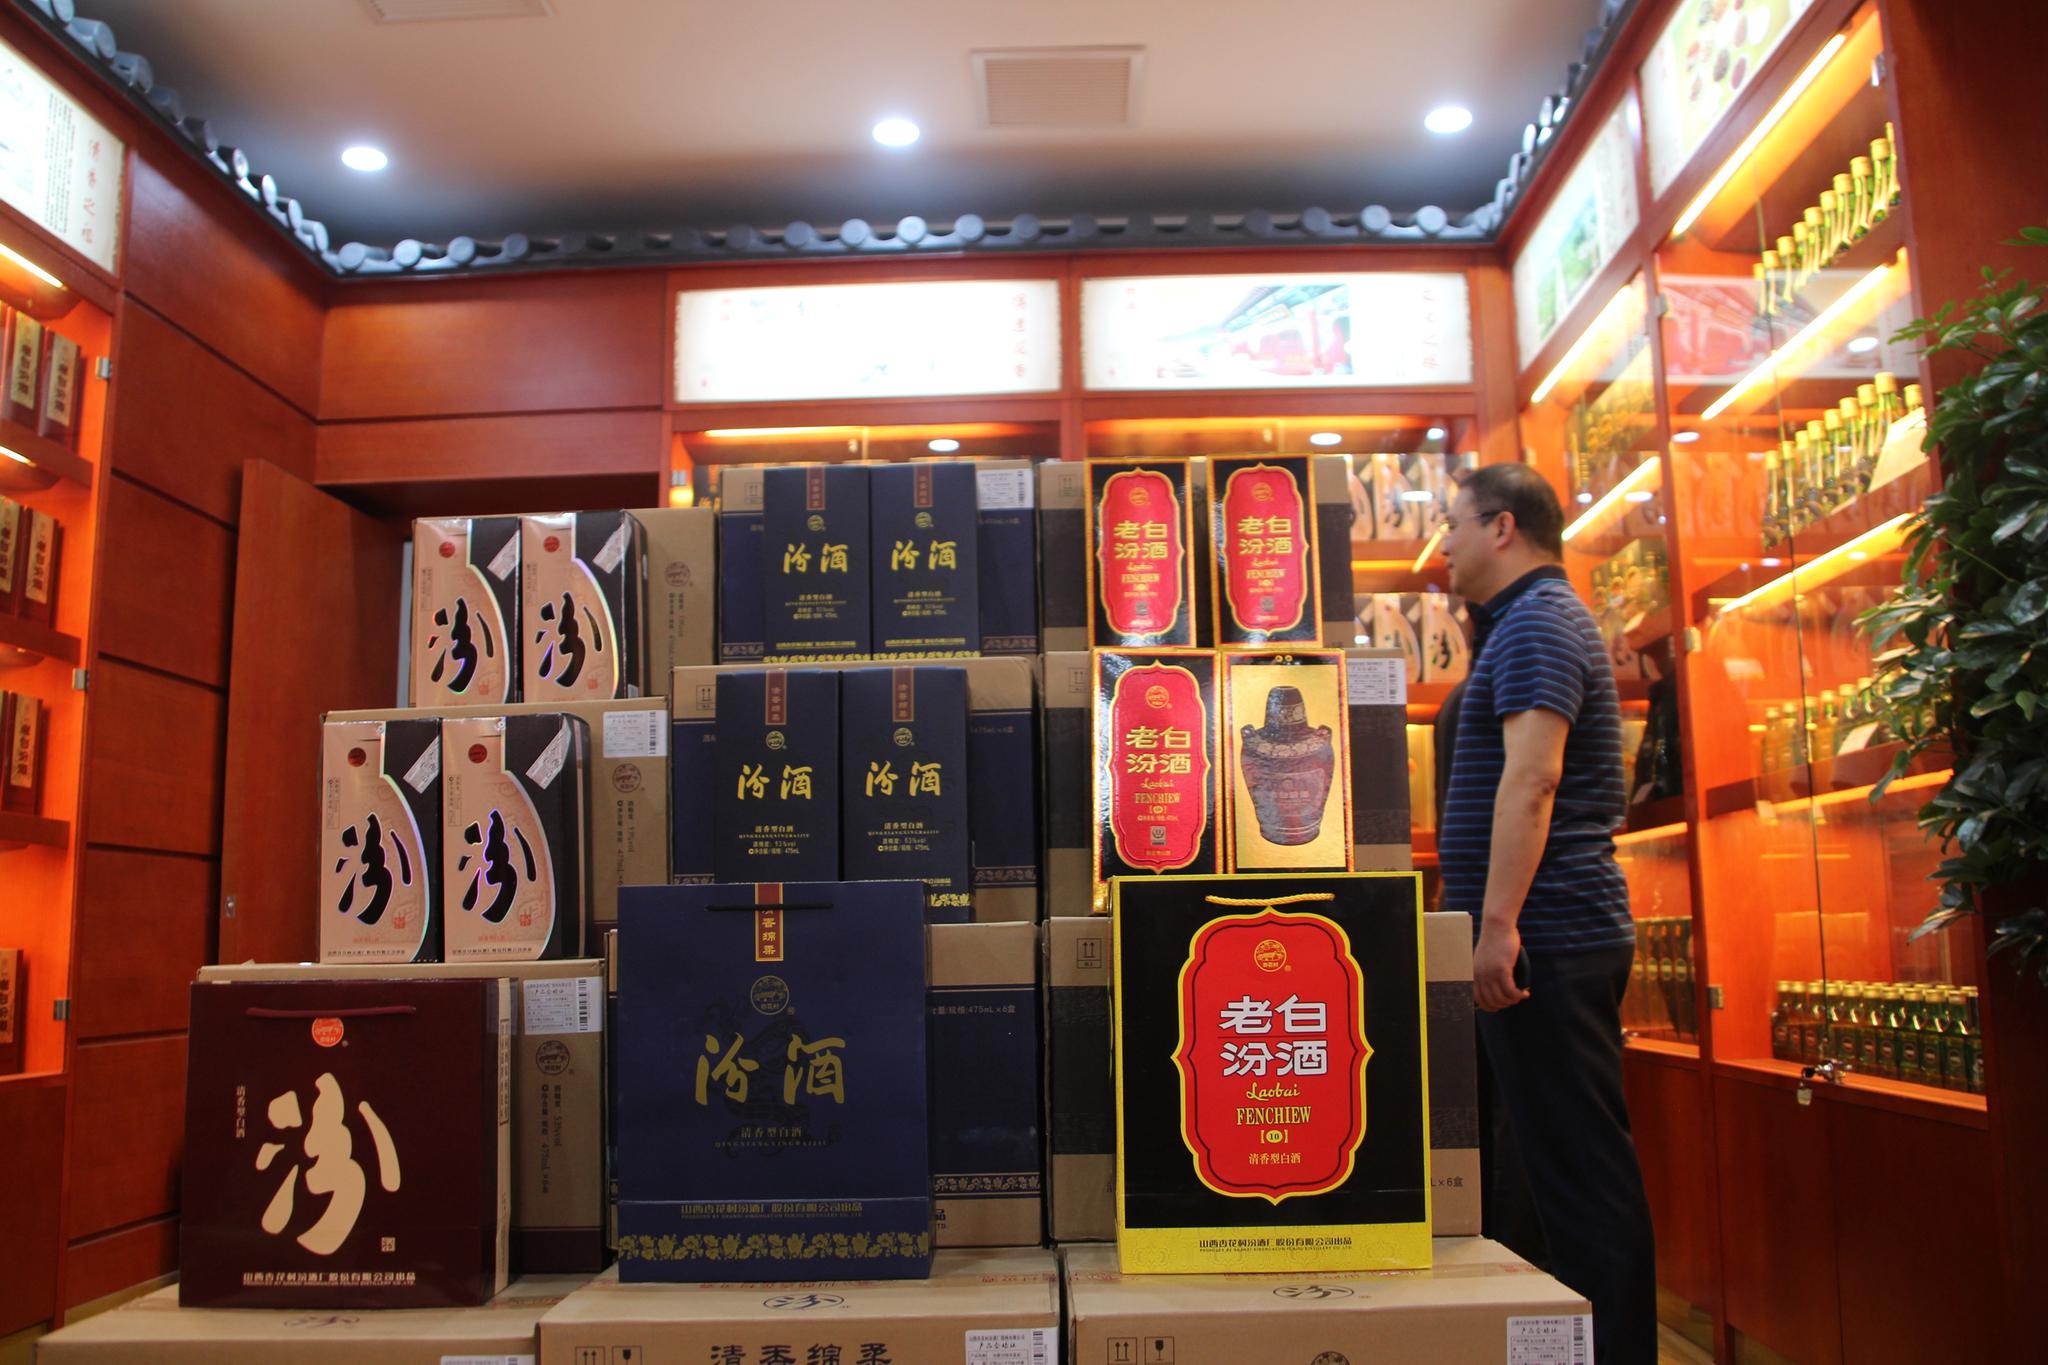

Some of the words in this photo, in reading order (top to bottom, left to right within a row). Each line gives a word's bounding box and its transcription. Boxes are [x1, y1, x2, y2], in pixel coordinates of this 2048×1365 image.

[1114, 520, 1168, 539] 老白
[1238, 516, 1292, 535] 老白
[783, 543, 848, 574] 汾酒
[891, 540, 957, 571] 汾酒
[1114, 542, 1169, 560] 汾酒
[1239, 537, 1293, 555] 汾酒
[1125, 725, 1192, 749] 老白
[1126, 752, 1192, 774] 汾酒
[737, 763, 813, 800] 汾酒
[865, 760, 942, 797] 汾酒
[335, 812, 413, 926] 汾
[458, 809, 537, 924] 汾
[1218, 994, 1329, 1035] 老白
[695, 1032, 847, 1106] 汾酒
[1218, 1039, 1329, 1077] 汾酒
[1246, 1081, 1301, 1102] Laobai
[1236, 1105, 1312, 1126] FENCHIEW
[740, 1126, 802, 1139] 清香型白酒
[255, 1072, 401, 1255] 汾
[1248, 1152, 1302, 1165] 清香型白酒
